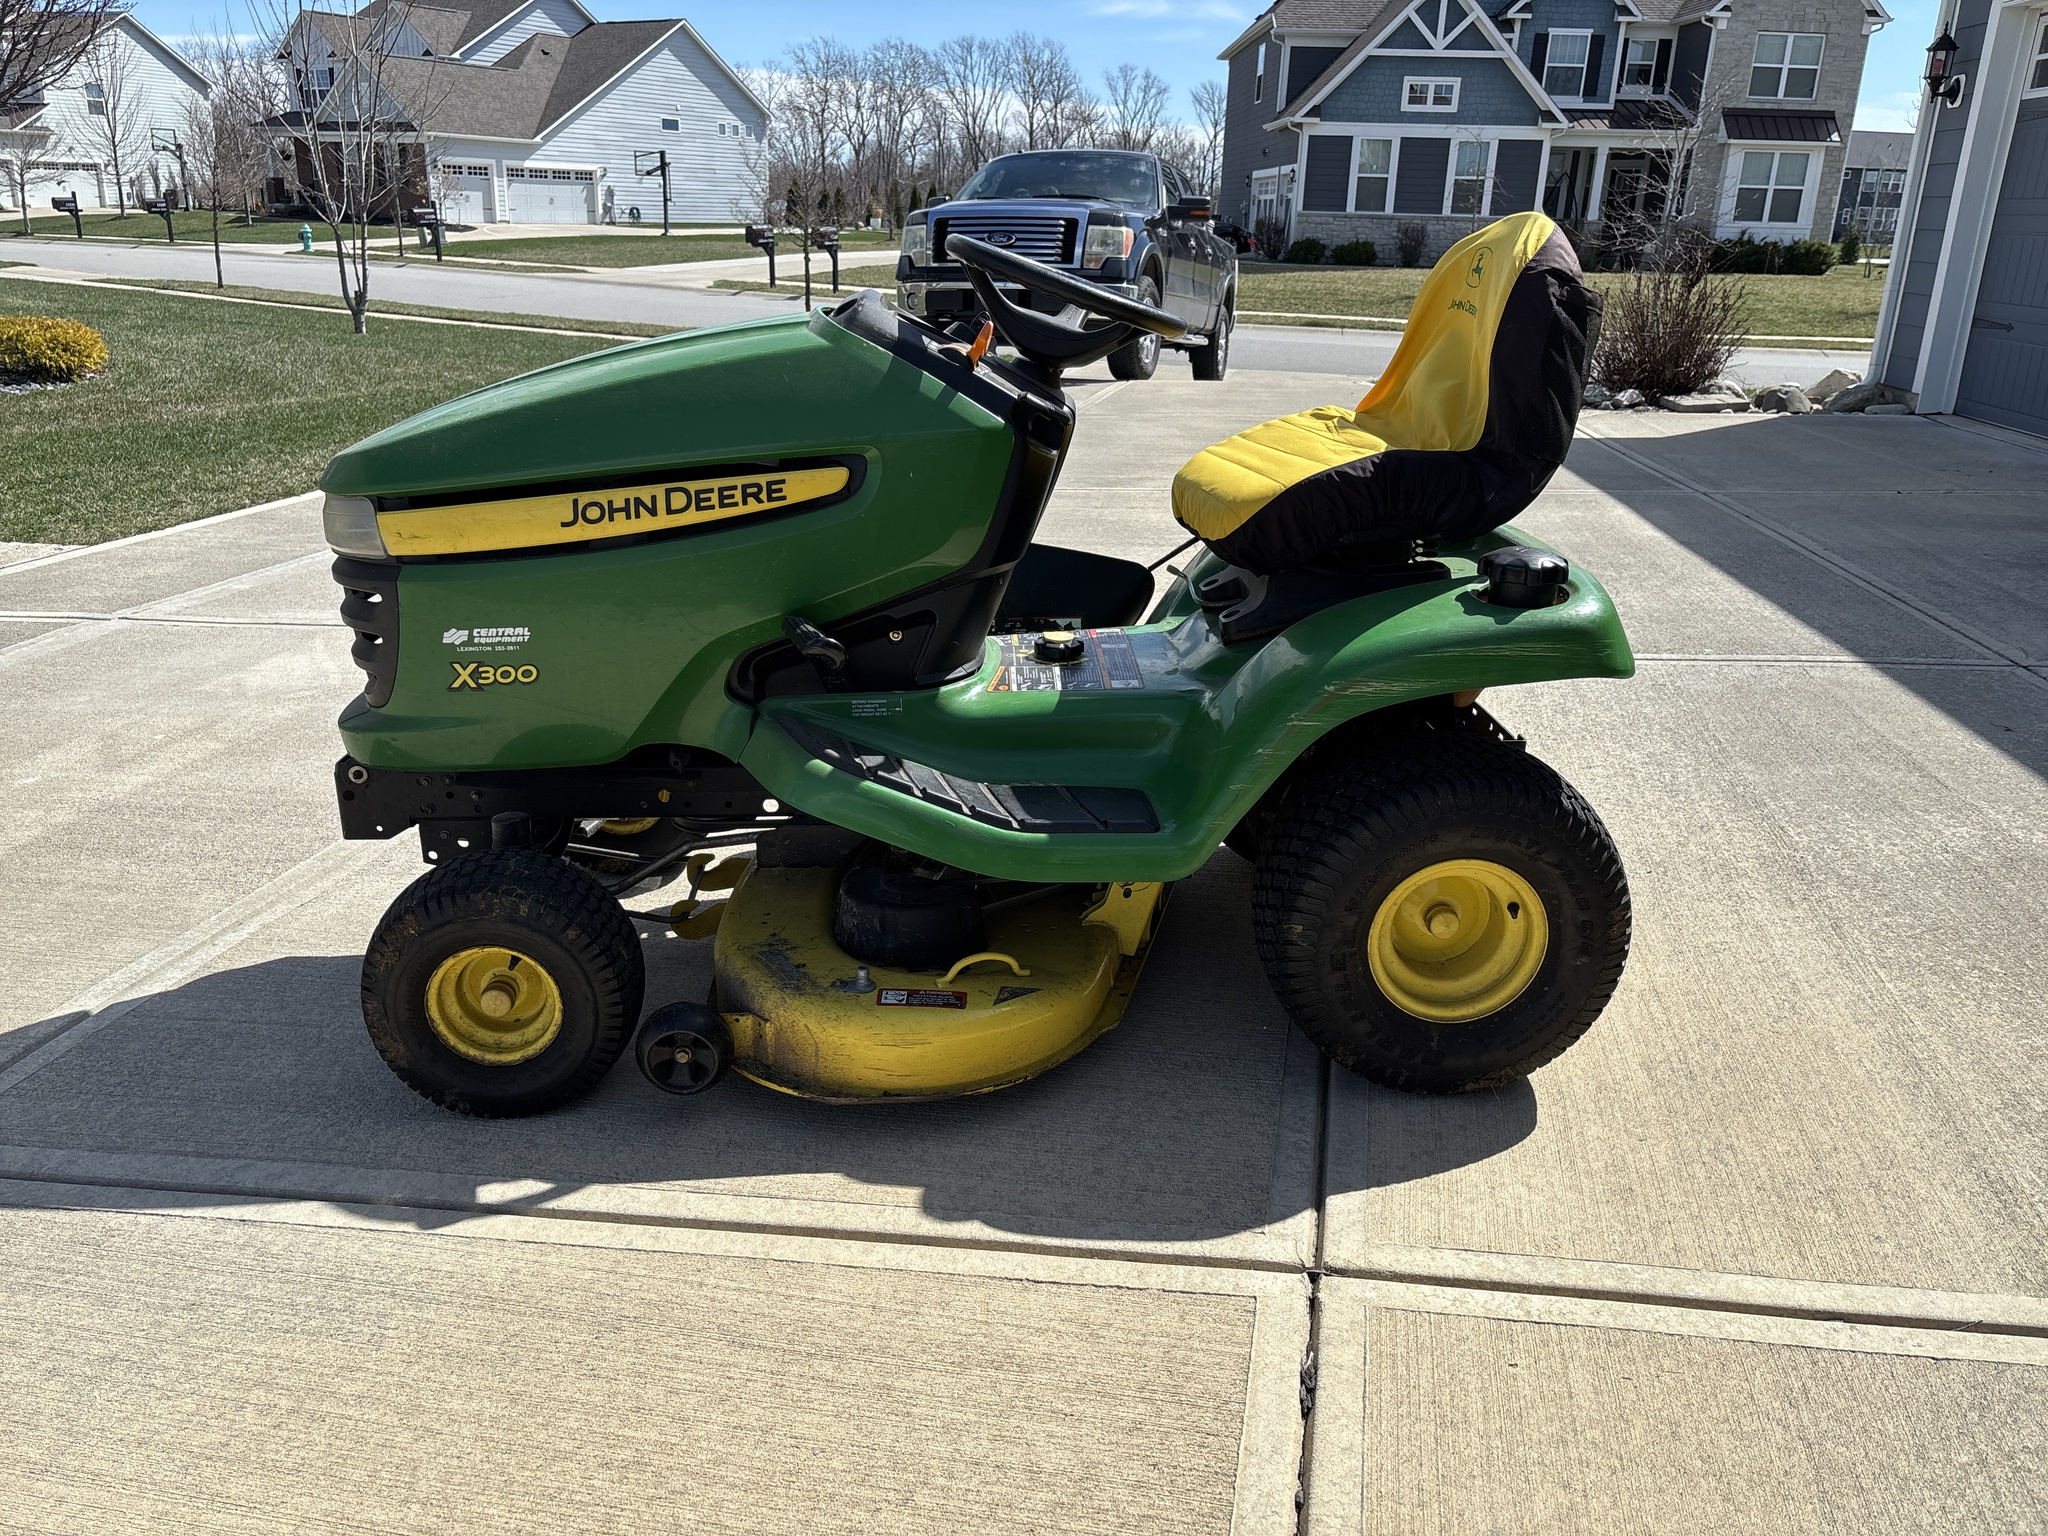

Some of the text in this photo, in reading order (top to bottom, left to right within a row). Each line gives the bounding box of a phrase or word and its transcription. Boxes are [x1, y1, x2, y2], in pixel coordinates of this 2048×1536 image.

[1448, 298, 1466, 311] JHN
[561, 479, 788, 527] JOHN DEERE
[473, 627, 531, 637] CENTRAL
[474, 636, 530, 644] EQUIPMENT
[448, 662, 540, 690] X300
[1470, 826, 1549, 856] MULTI
[1553, 858, 1591, 911] TRAC
[1330, 953, 1445, 1066] CARLISLE
